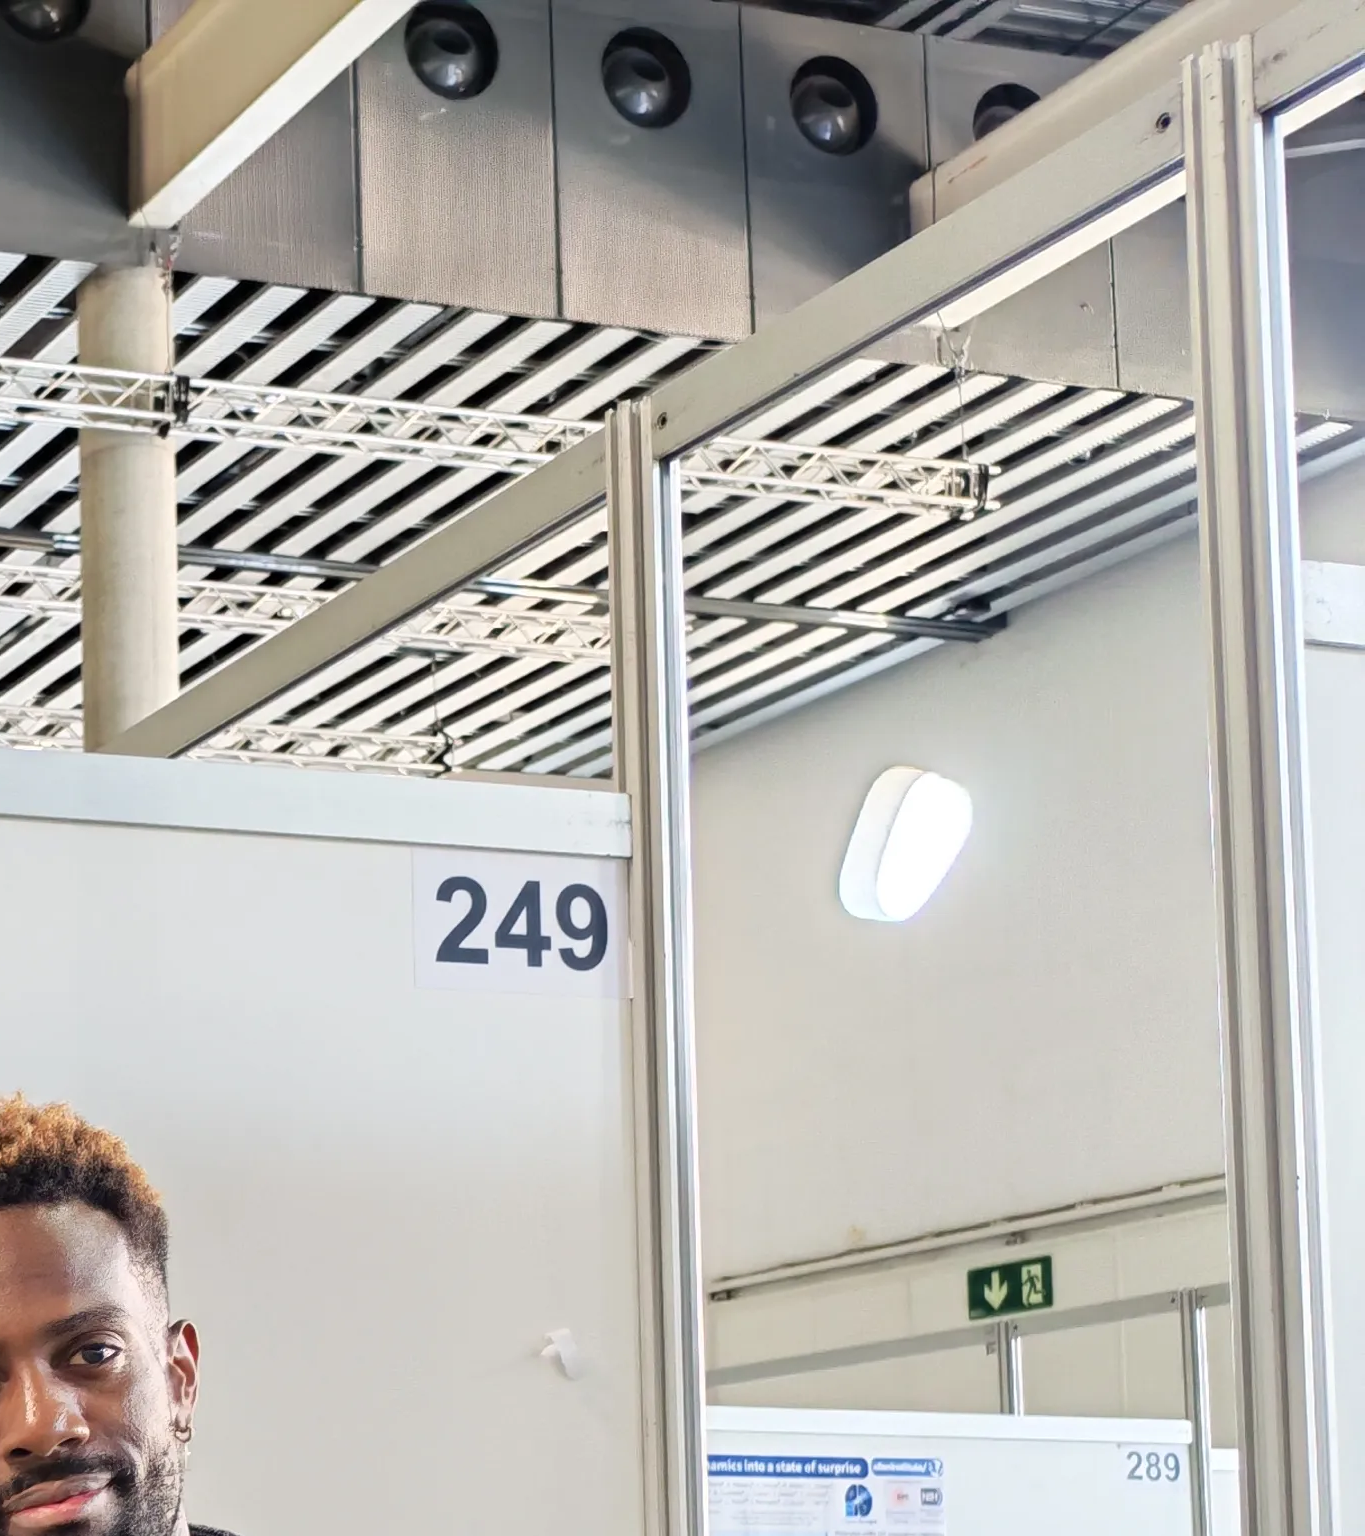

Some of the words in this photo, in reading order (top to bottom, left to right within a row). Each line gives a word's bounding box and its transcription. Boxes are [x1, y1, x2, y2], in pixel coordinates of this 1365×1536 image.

[435, 875, 608, 971] 249
[745, 1459, 765, 1472] into
[768, 1462, 774, 1472] a
[776, 1461, 801, 1473] state
[804, 1461, 815, 1473] of
[818, 1462, 861, 1475] surprise
[1126, 1451, 1181, 1481] 289
